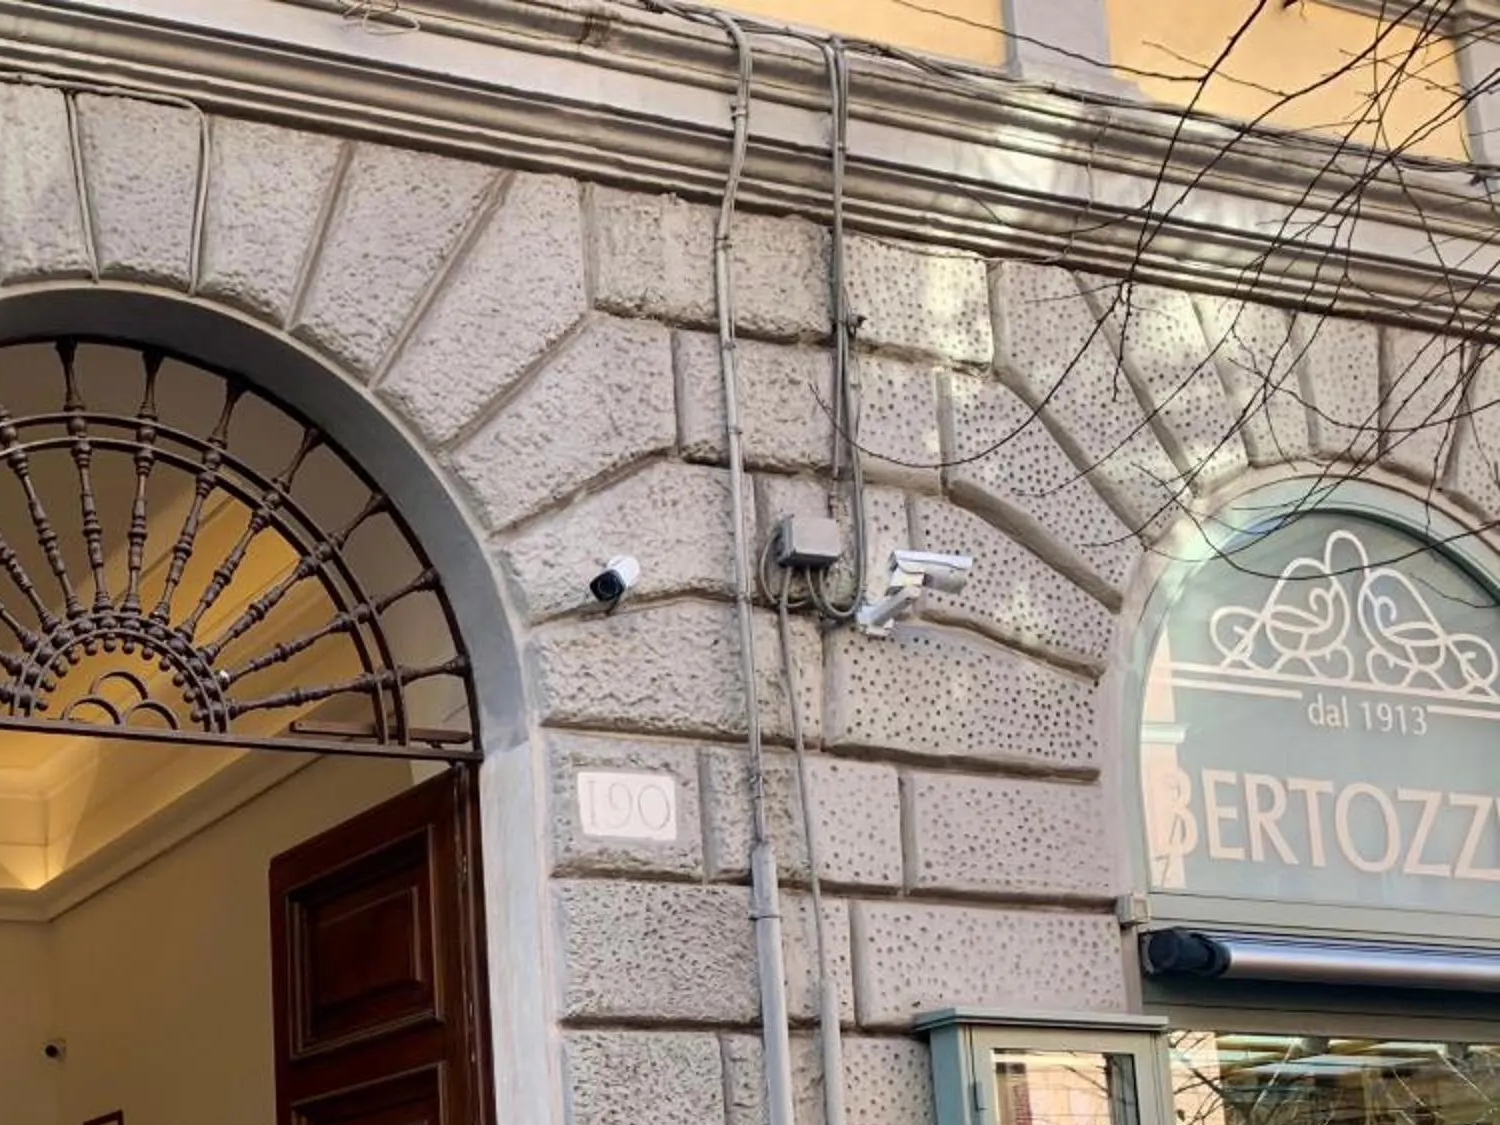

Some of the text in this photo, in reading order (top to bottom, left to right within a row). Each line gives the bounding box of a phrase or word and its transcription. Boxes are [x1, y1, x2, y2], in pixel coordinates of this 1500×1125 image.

[1308, 693, 1429, 737] dal 1913
[1158, 768, 1500, 881] BERTOZZ
